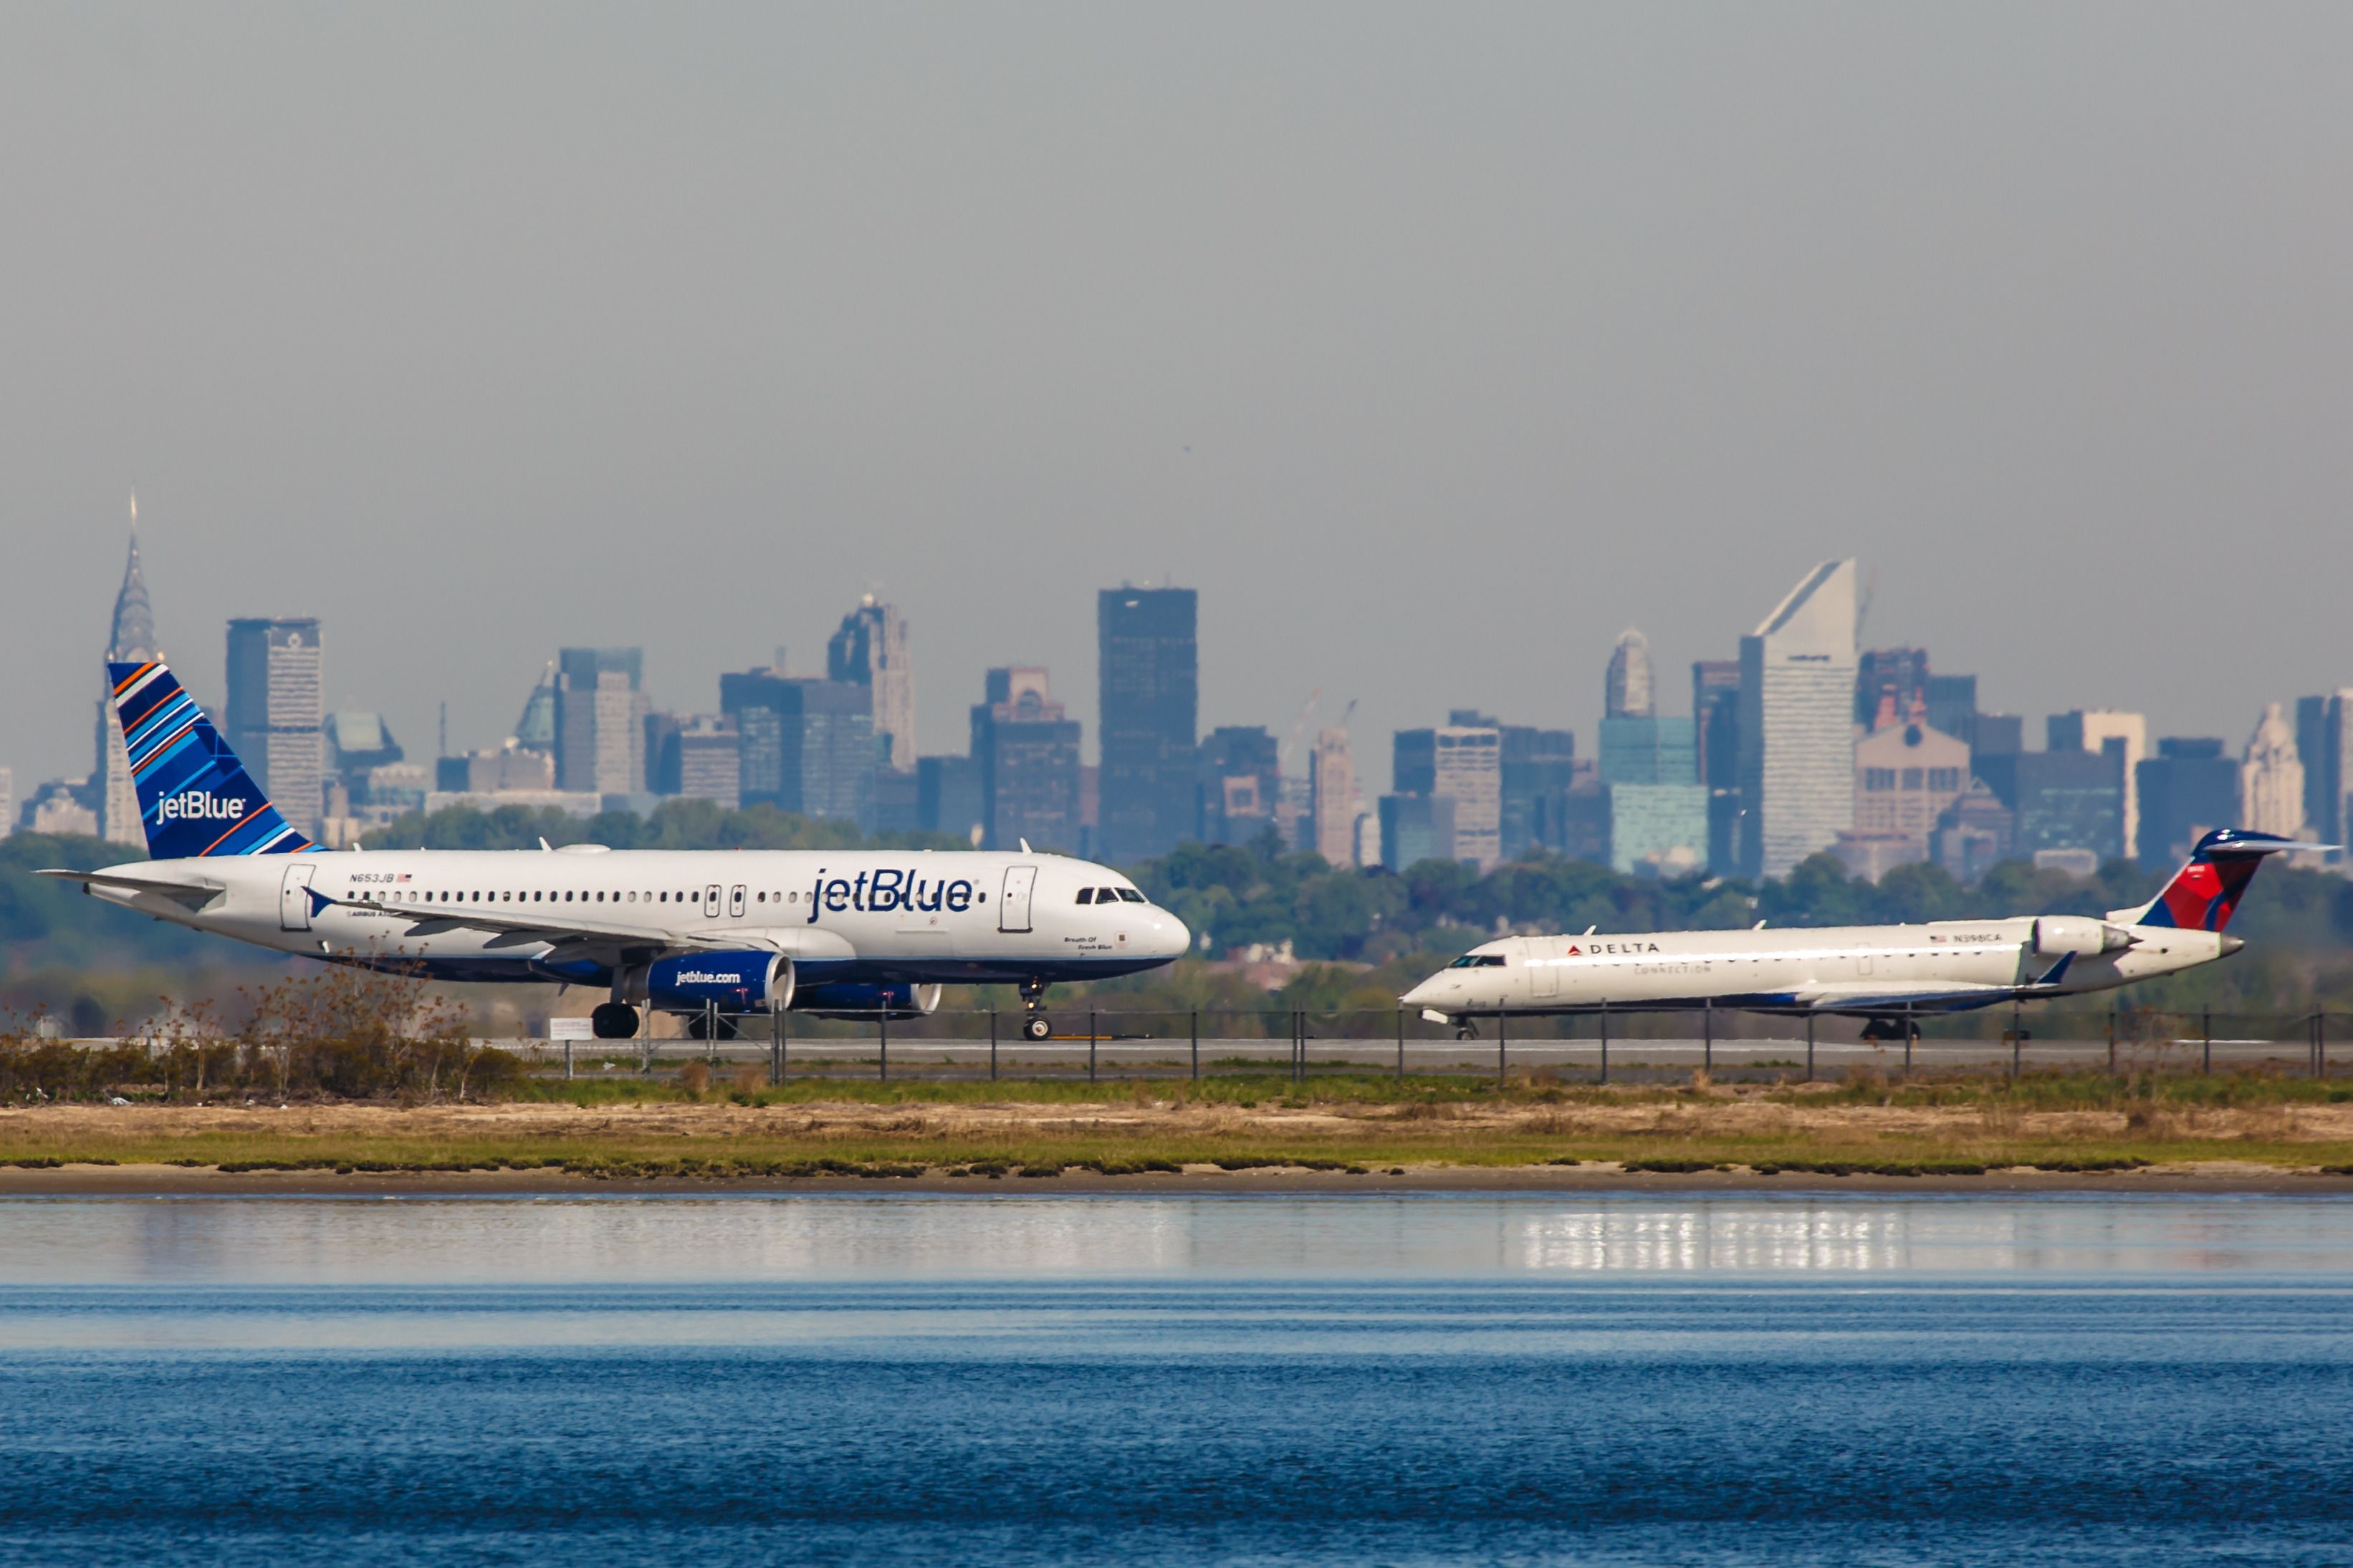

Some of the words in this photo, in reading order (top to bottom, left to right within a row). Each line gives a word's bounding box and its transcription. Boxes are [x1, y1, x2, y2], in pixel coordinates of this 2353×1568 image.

[156, 791, 244, 825] jetBlue
[350, 873, 394, 882] N653JB
[807, 868, 973, 924] jetBlue
[1590, 943, 1660, 954] DELTA
[675, 971, 742, 986] jetblue.com
